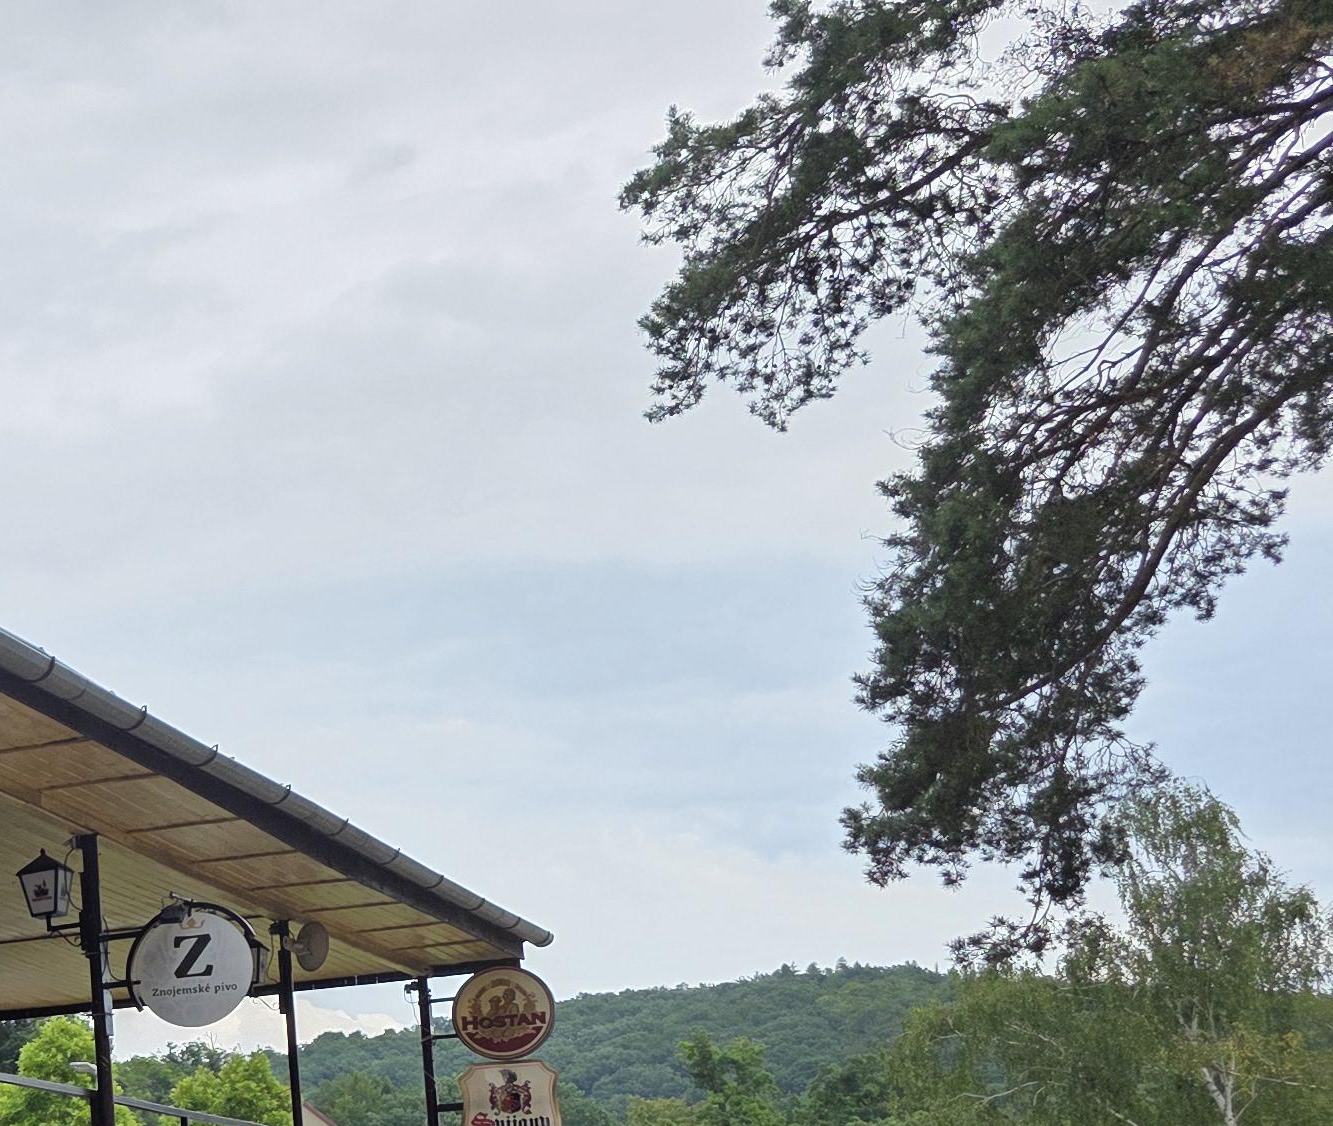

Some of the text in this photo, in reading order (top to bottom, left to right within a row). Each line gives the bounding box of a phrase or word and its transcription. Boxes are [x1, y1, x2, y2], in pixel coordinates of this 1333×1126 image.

[173, 933, 213, 978] Z
[152, 982, 238, 997] Znojemské pivo
[461, 1011, 546, 1031] HOSTAN
